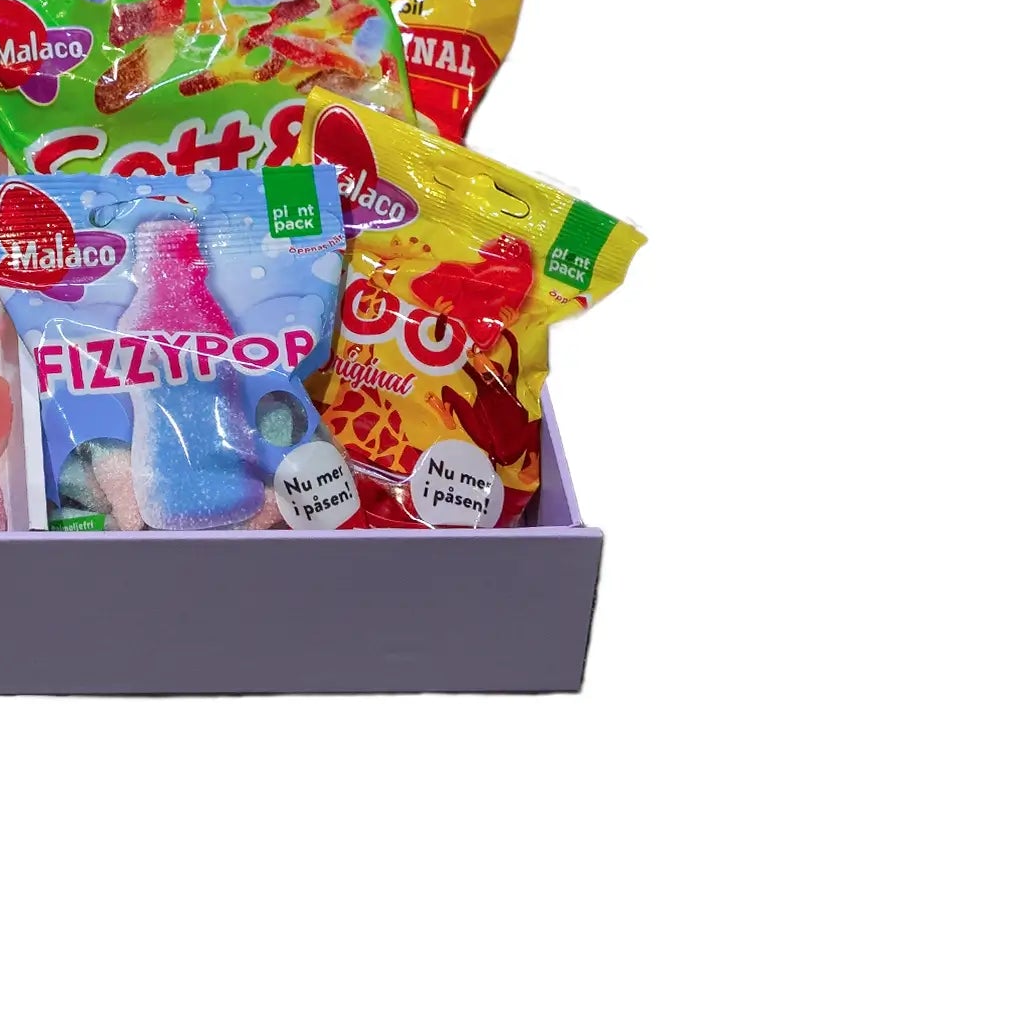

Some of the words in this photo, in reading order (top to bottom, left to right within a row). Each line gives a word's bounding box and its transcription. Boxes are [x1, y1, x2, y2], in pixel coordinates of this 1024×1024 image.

[272, 203, 315, 220] plnt
[337, 168, 406, 223] alaco
[273, 218, 315, 234] pack
[7, 232, 116, 271] Malaco
[551, 247, 591, 271] plnt
[548, 259, 587, 284] pack
[32, 328, 315, 393] FIZZYPOP
[334, 349, 417, 396] riginal
[283, 477, 313, 496] Nu
[316, 465, 344, 487] mer
[427, 457, 455, 480] Nu
[460, 472, 492, 490] mer
[291, 500, 301, 516] i
[303, 481, 353, 521] påsen!
[423, 480, 431, 497] i
[432, 486, 490, 515] påsen!
